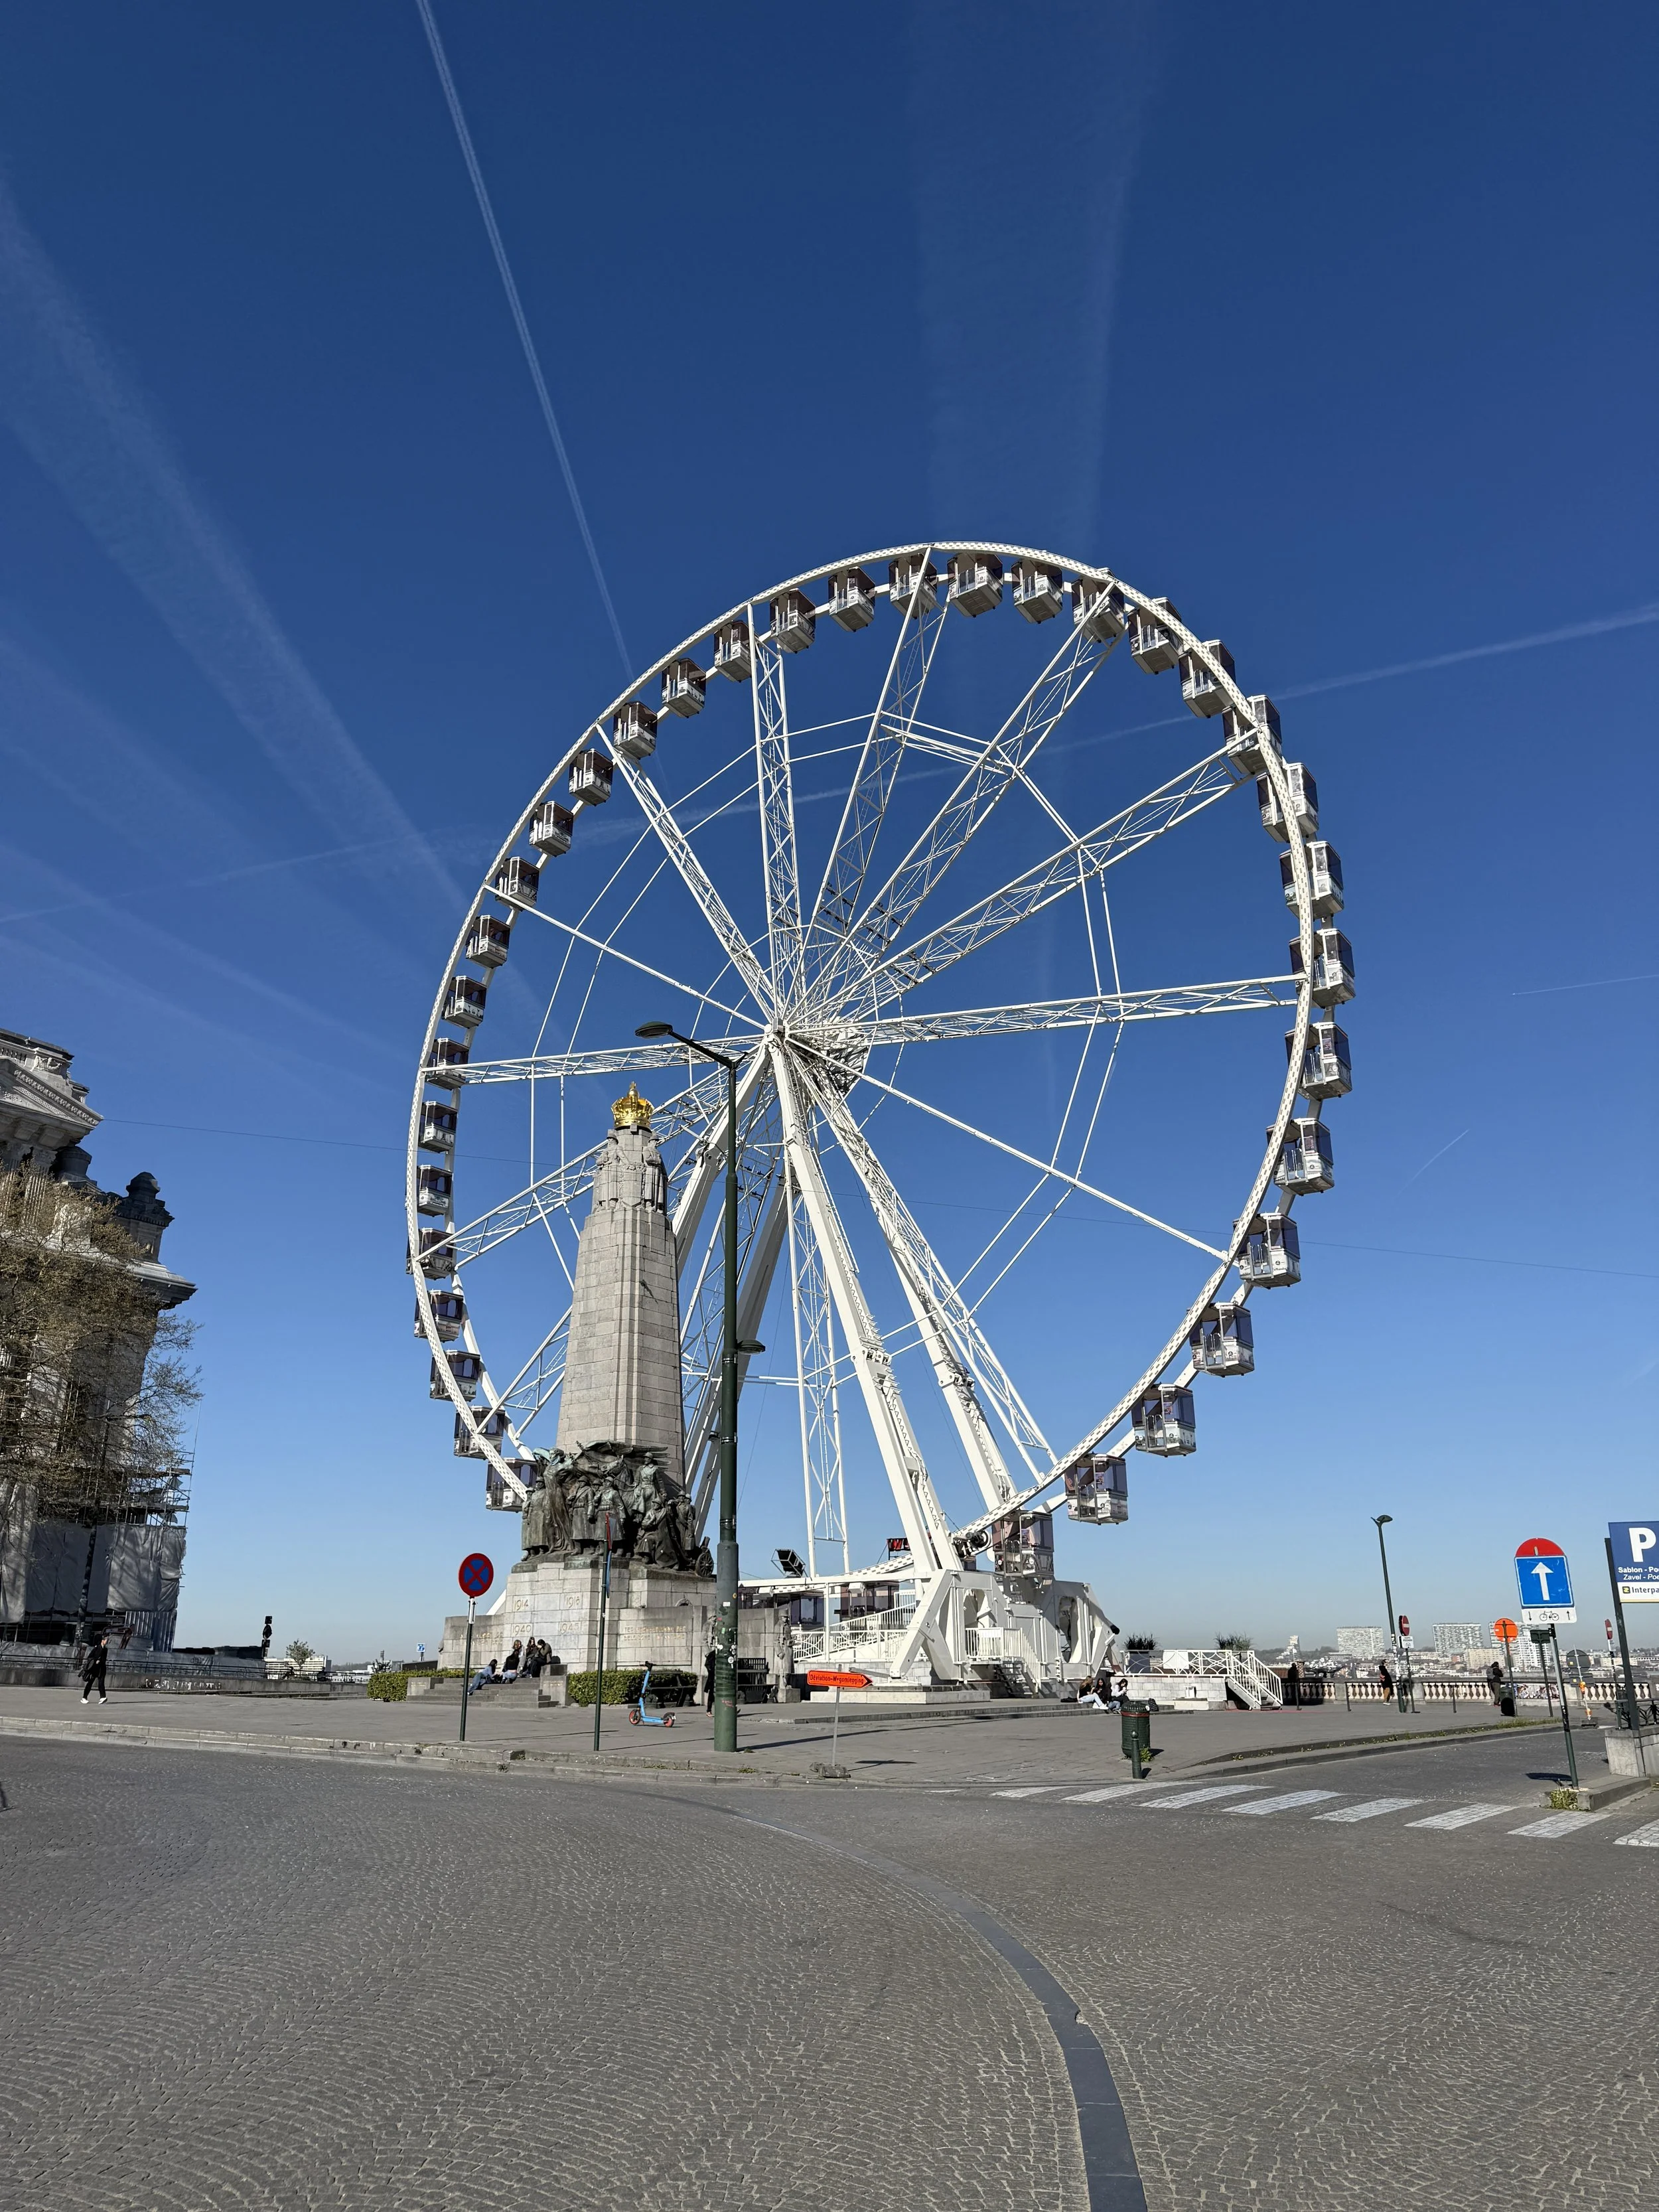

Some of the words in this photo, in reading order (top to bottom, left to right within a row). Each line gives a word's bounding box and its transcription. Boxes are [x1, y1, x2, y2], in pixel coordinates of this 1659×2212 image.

[1628, 1527, 1656, 1562] P
[514, 1599, 529, 1611] 1914
[512, 1625, 532, 1636] 1940
[559, 1623, 579, 1635] 1945
